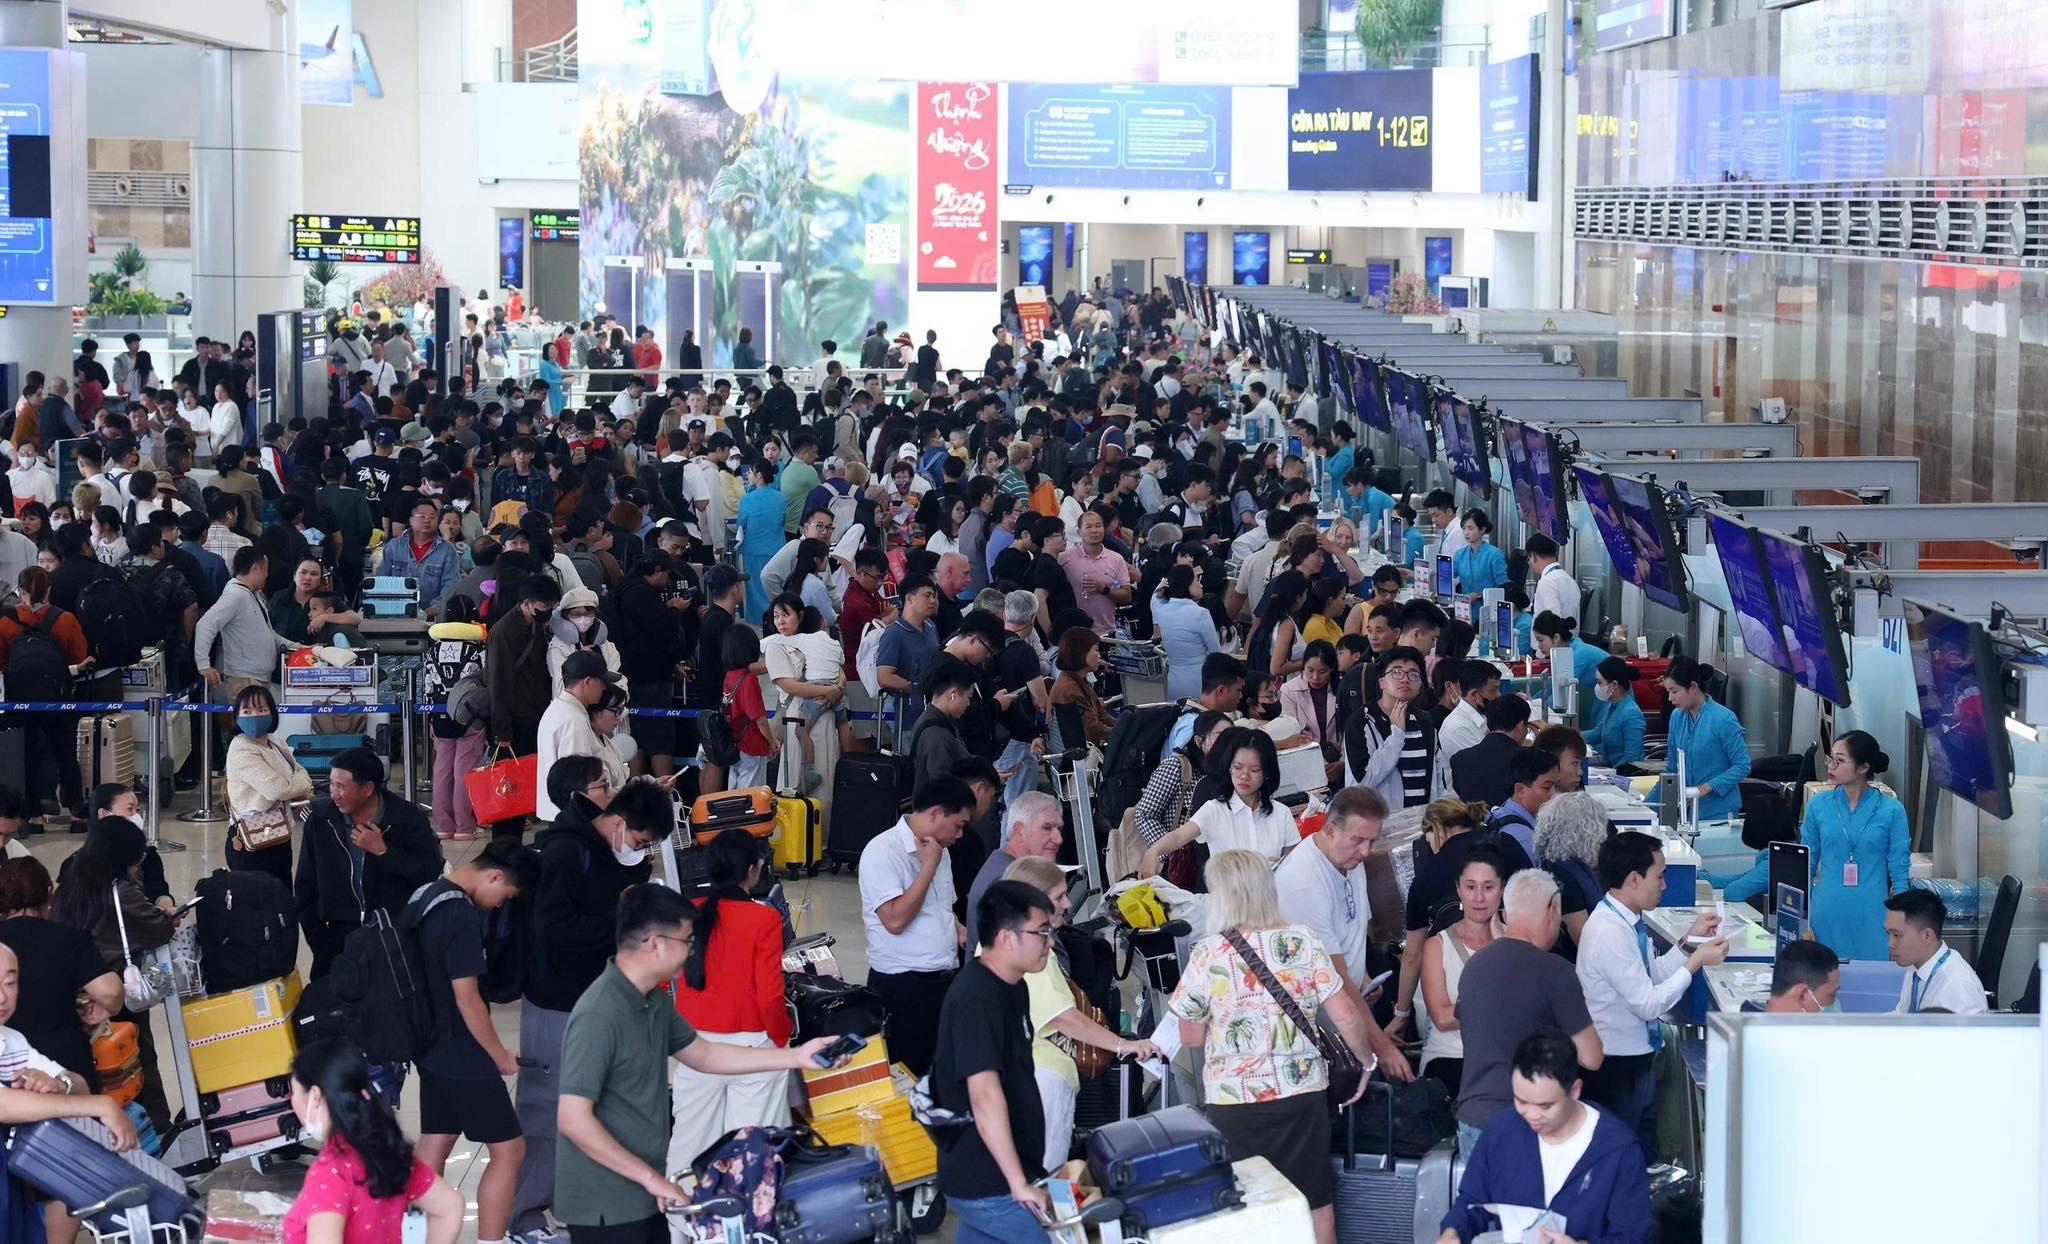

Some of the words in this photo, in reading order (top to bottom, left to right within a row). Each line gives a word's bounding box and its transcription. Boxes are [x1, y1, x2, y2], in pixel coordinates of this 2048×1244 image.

[1377, 116, 1408, 147] 1-12
[932, 182, 986, 216] 2026
[321, 216, 331, 228] E
[384, 219, 395, 230] A
